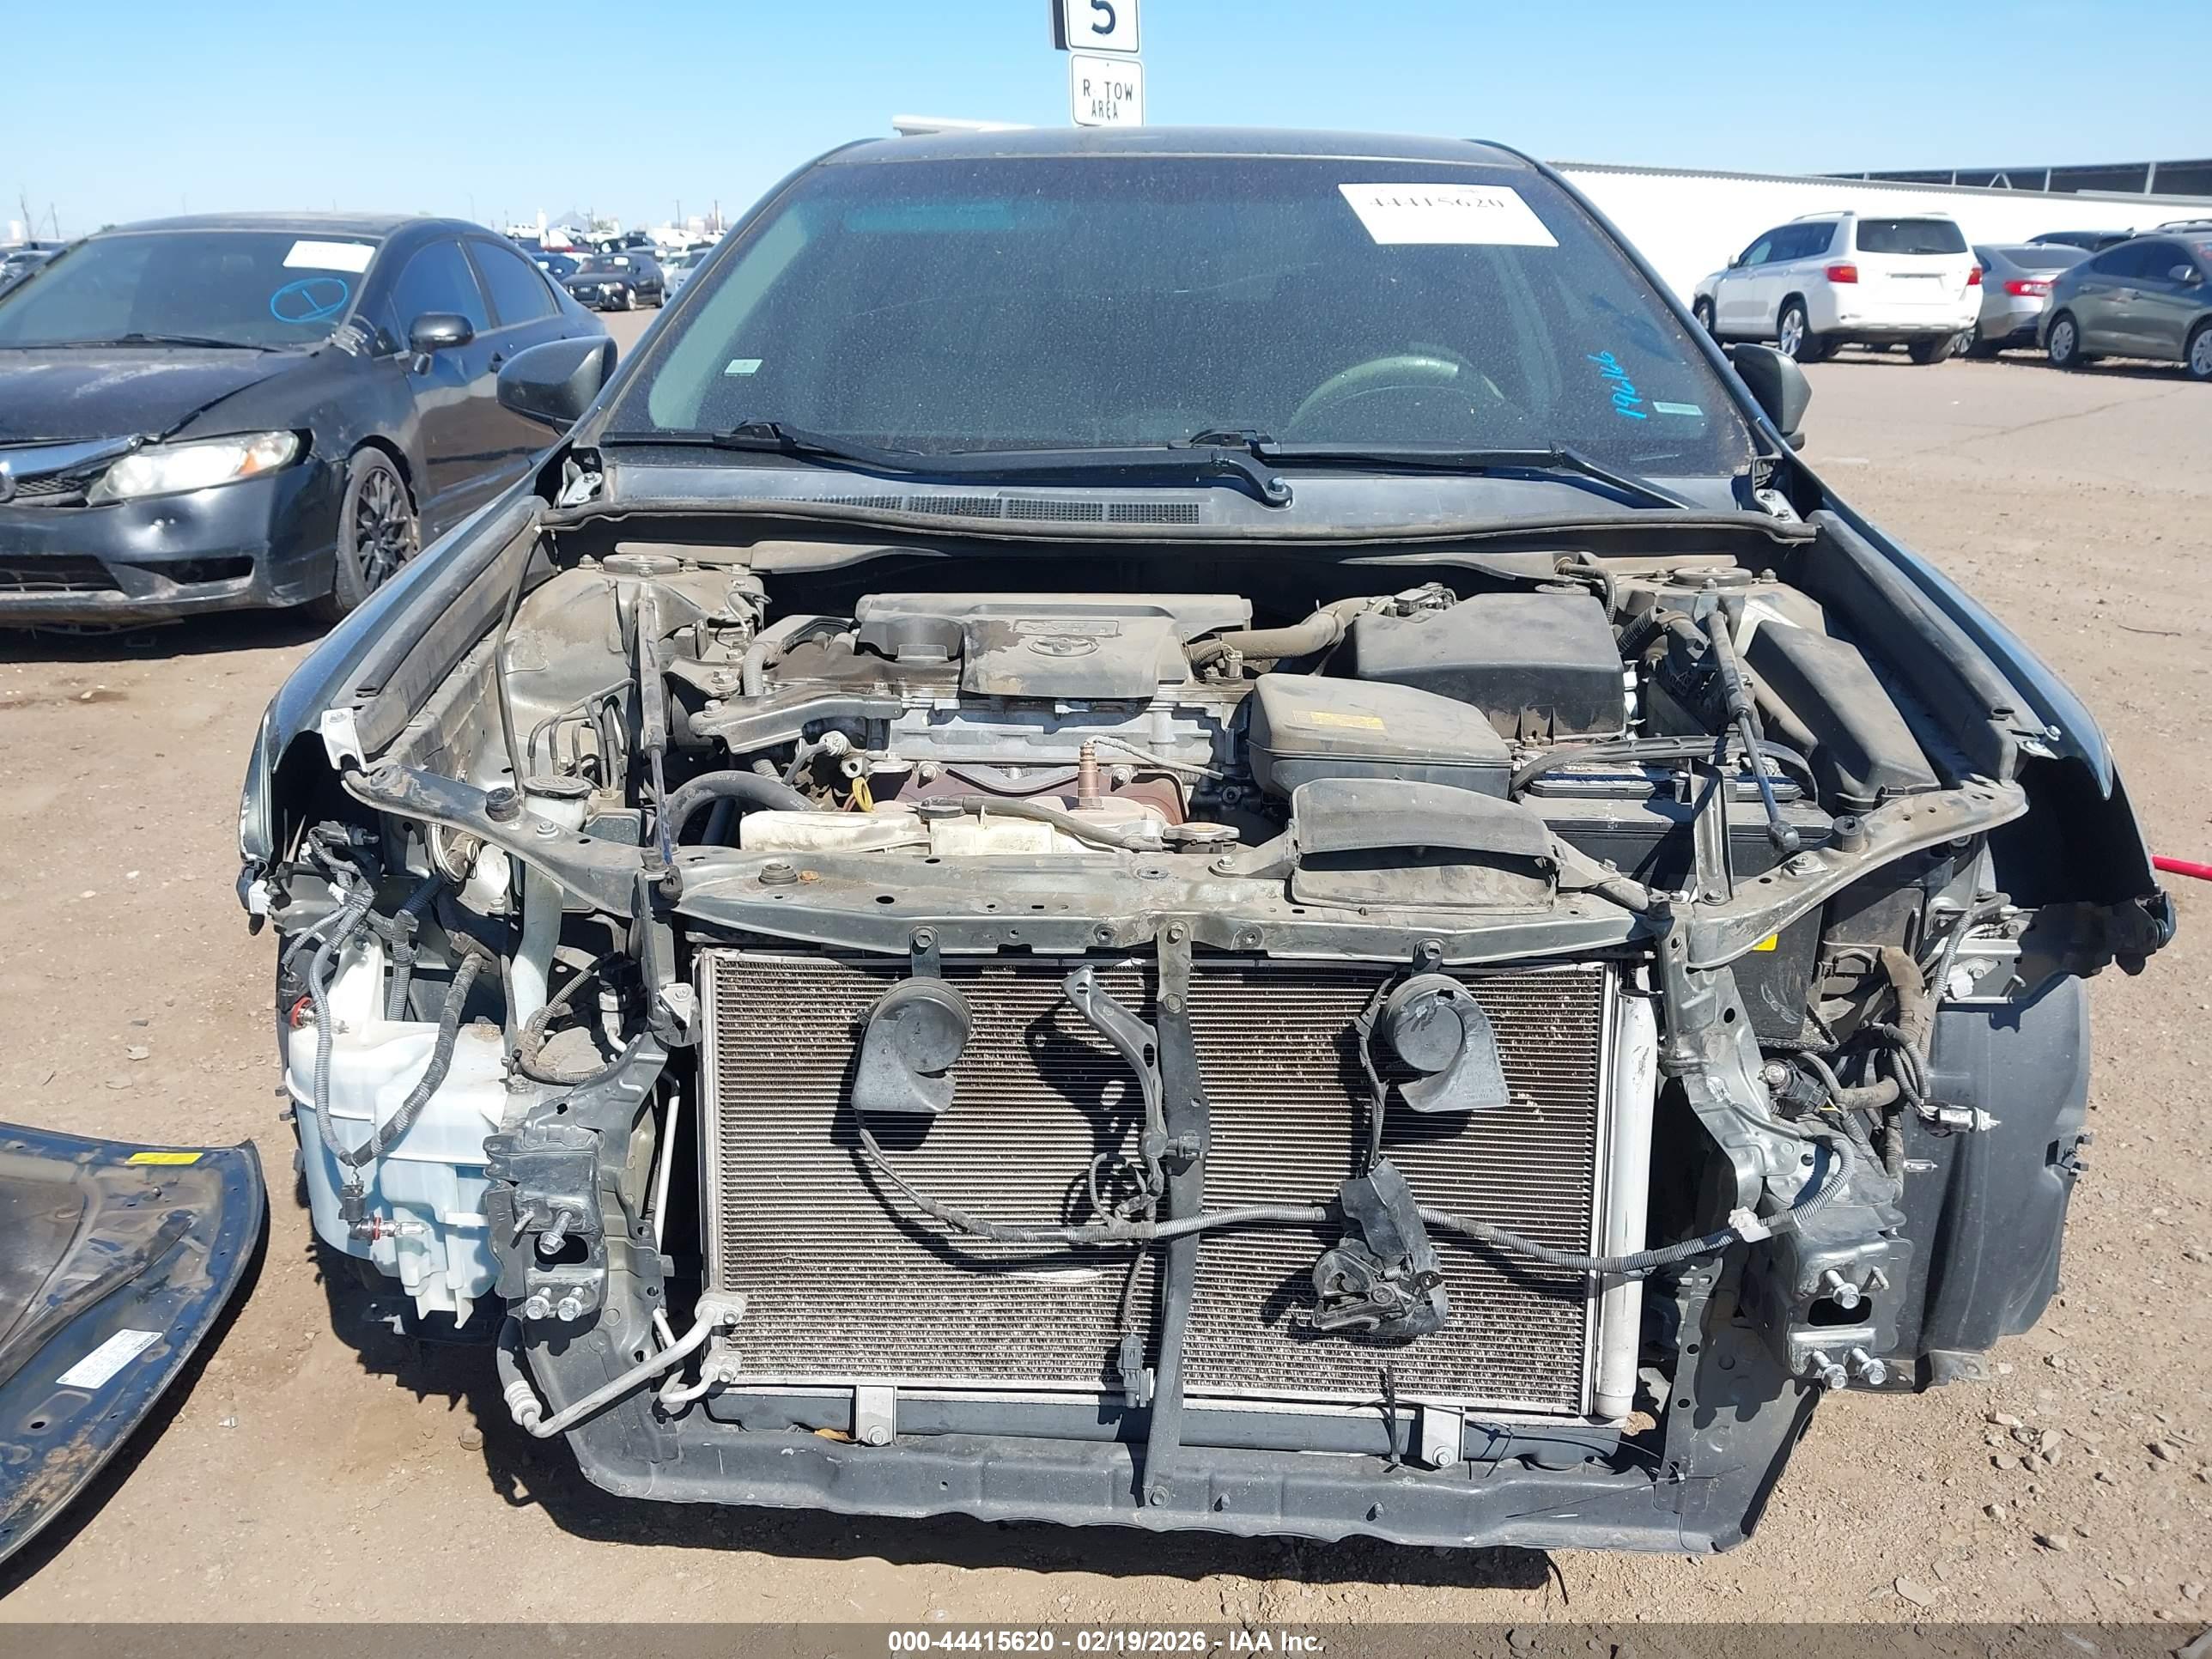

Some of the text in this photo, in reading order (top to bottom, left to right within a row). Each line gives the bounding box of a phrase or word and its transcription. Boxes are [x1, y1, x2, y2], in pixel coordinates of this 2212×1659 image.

[1091, 0, 1116, 35] 5
[1103, 82, 1133, 102] TOW
[1091, 99, 1119, 121] AREA
